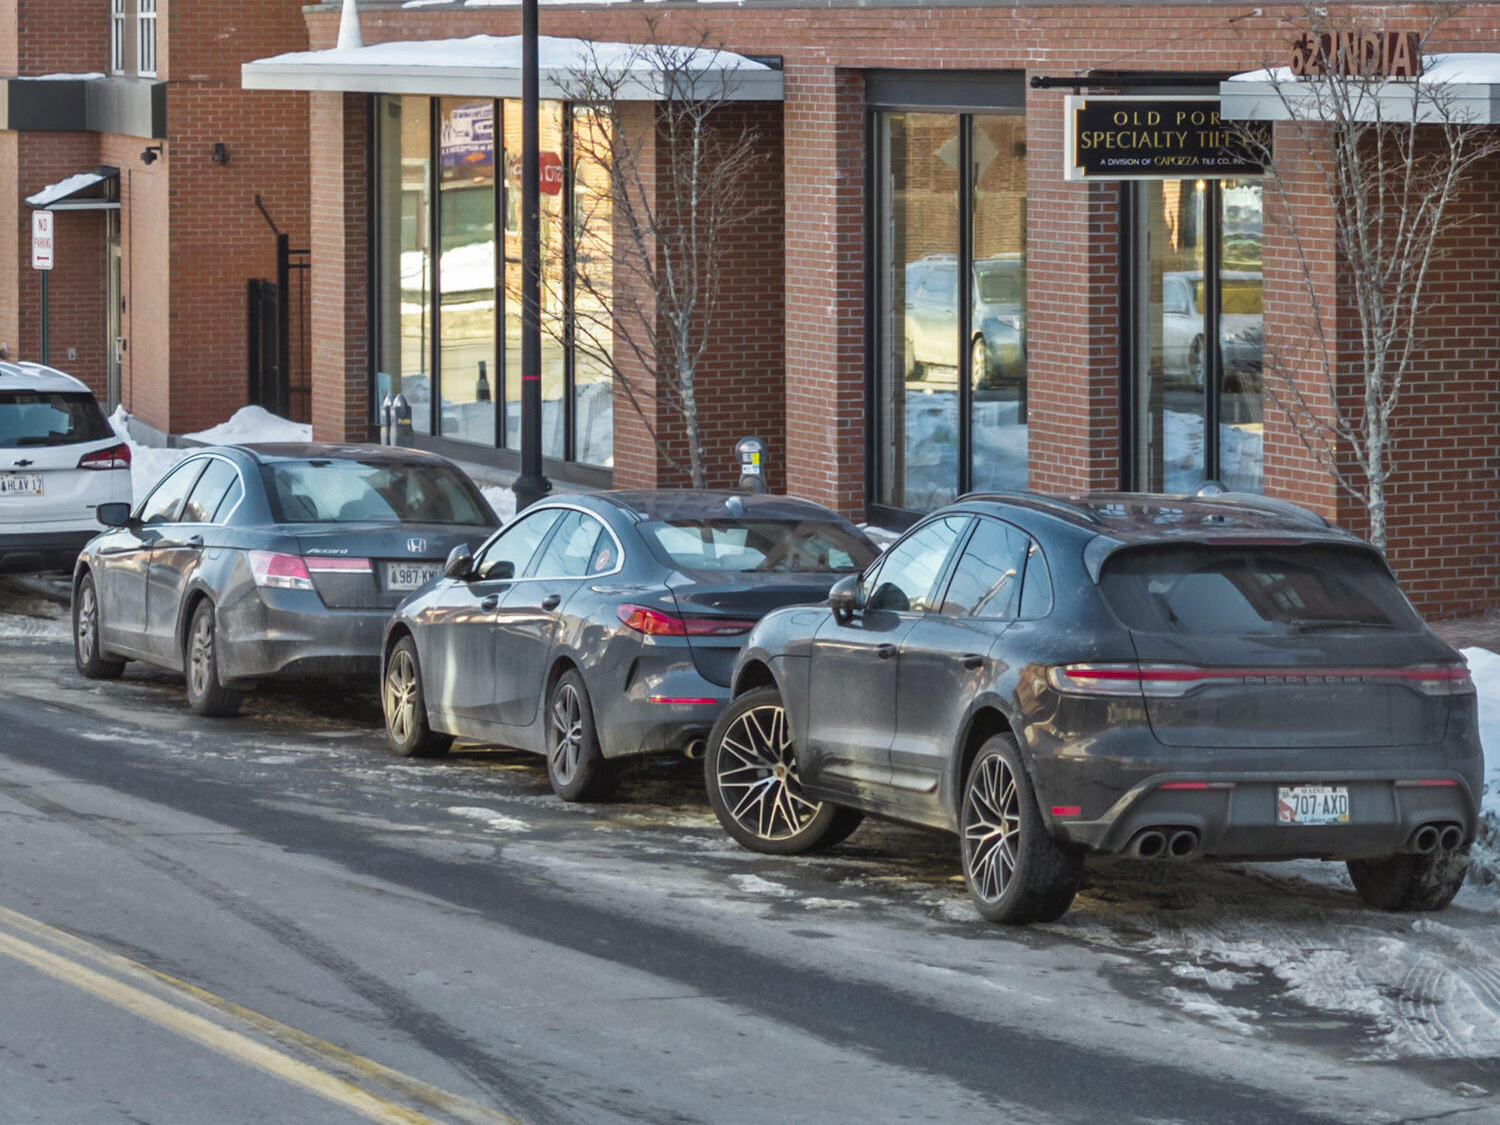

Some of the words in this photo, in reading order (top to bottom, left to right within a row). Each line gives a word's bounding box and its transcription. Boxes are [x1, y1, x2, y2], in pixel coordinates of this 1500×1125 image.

[1289, 32, 1320, 76] 62
[1329, 31, 1412, 76] INDIA
[1113, 111, 1161, 125] OLD
[1176, 111, 1222, 125] POR
[1081, 131, 1188, 149] SPECIALTY
[1100, 158, 1107, 166] A
[1107, 158, 1139, 166] DIVISION
[1141, 158, 1151, 166] OF
[1202, 158, 1215, 166] TILE
[38, 218, 48, 232] NO
[307, 547, 349, 555] Accord
